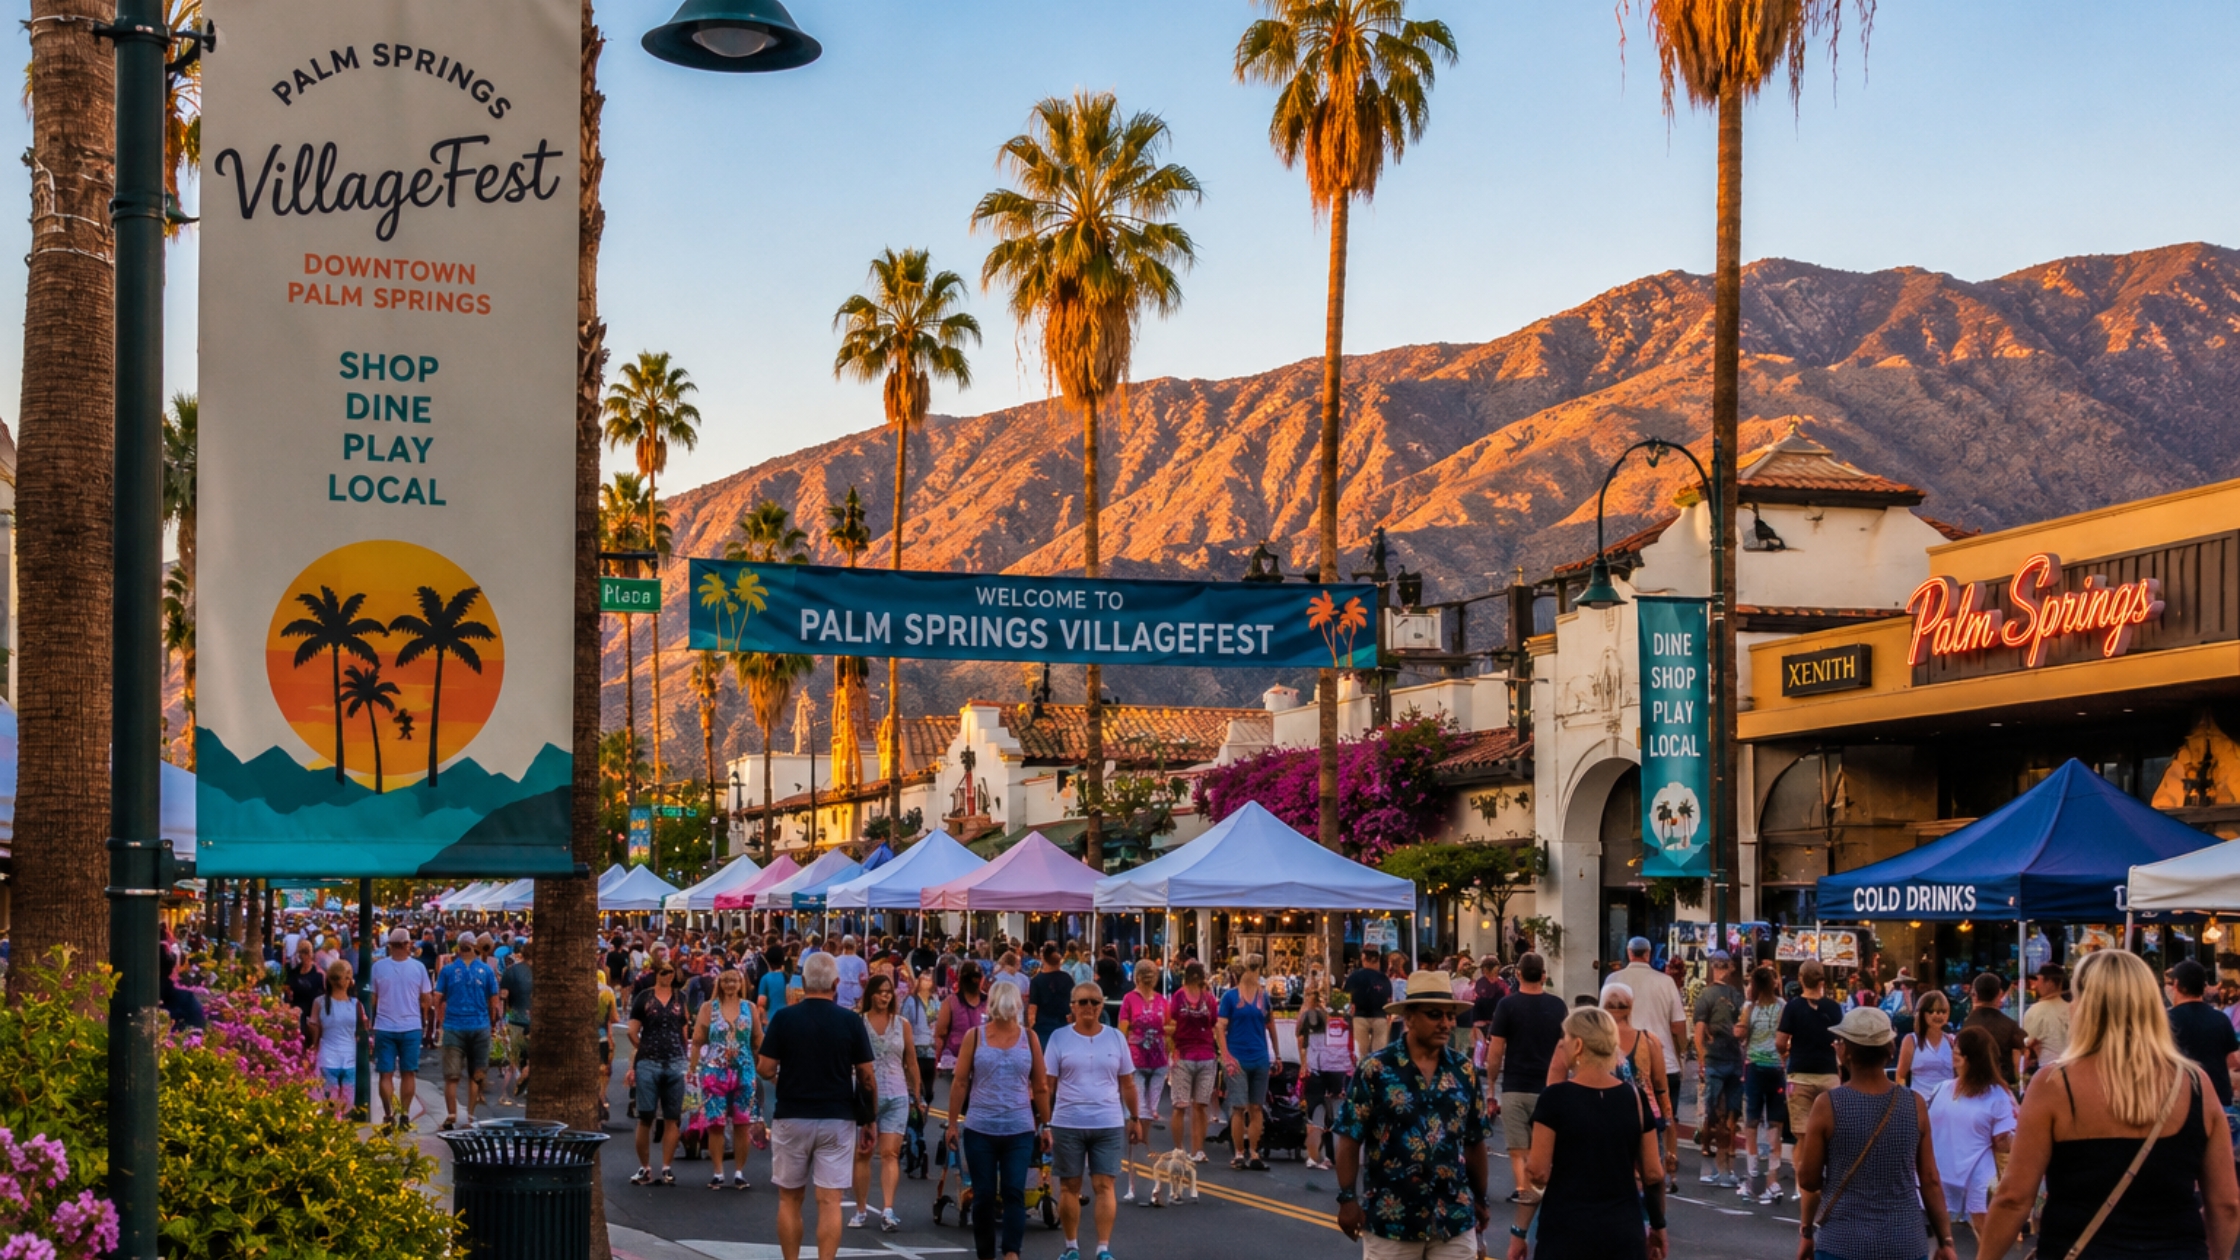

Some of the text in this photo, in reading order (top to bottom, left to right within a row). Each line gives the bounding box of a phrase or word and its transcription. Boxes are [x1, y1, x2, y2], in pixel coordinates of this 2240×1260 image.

[271, 42, 512, 120] PALM SPRINGS
[213, 134, 564, 242] VillageFest
[302, 252, 476, 286] DOWNTOWN
[287, 281, 492, 316] PALM SPRINGS
[339, 351, 440, 383] SHOP
[346, 392, 432, 424] DINE
[343, 433, 434, 463] PLAY
[328, 474, 447, 507] LOCAL
[975, 586, 1124, 610] WELCOME TO
[1905, 552, 2152, 668] Palm Springs
[800, 608, 1275, 655] PALM SPRINGS VILLAGEFEST
[1653, 632, 1693, 656] DINE
[1651, 666, 1697, 690] SHOP
[1787, 655, 1856, 688] XENITH
[1653, 700, 1694, 724] PLAY
[1650, 734, 1701, 758] LOCAL
[1852, 885, 1977, 912] COLD DRINKS
